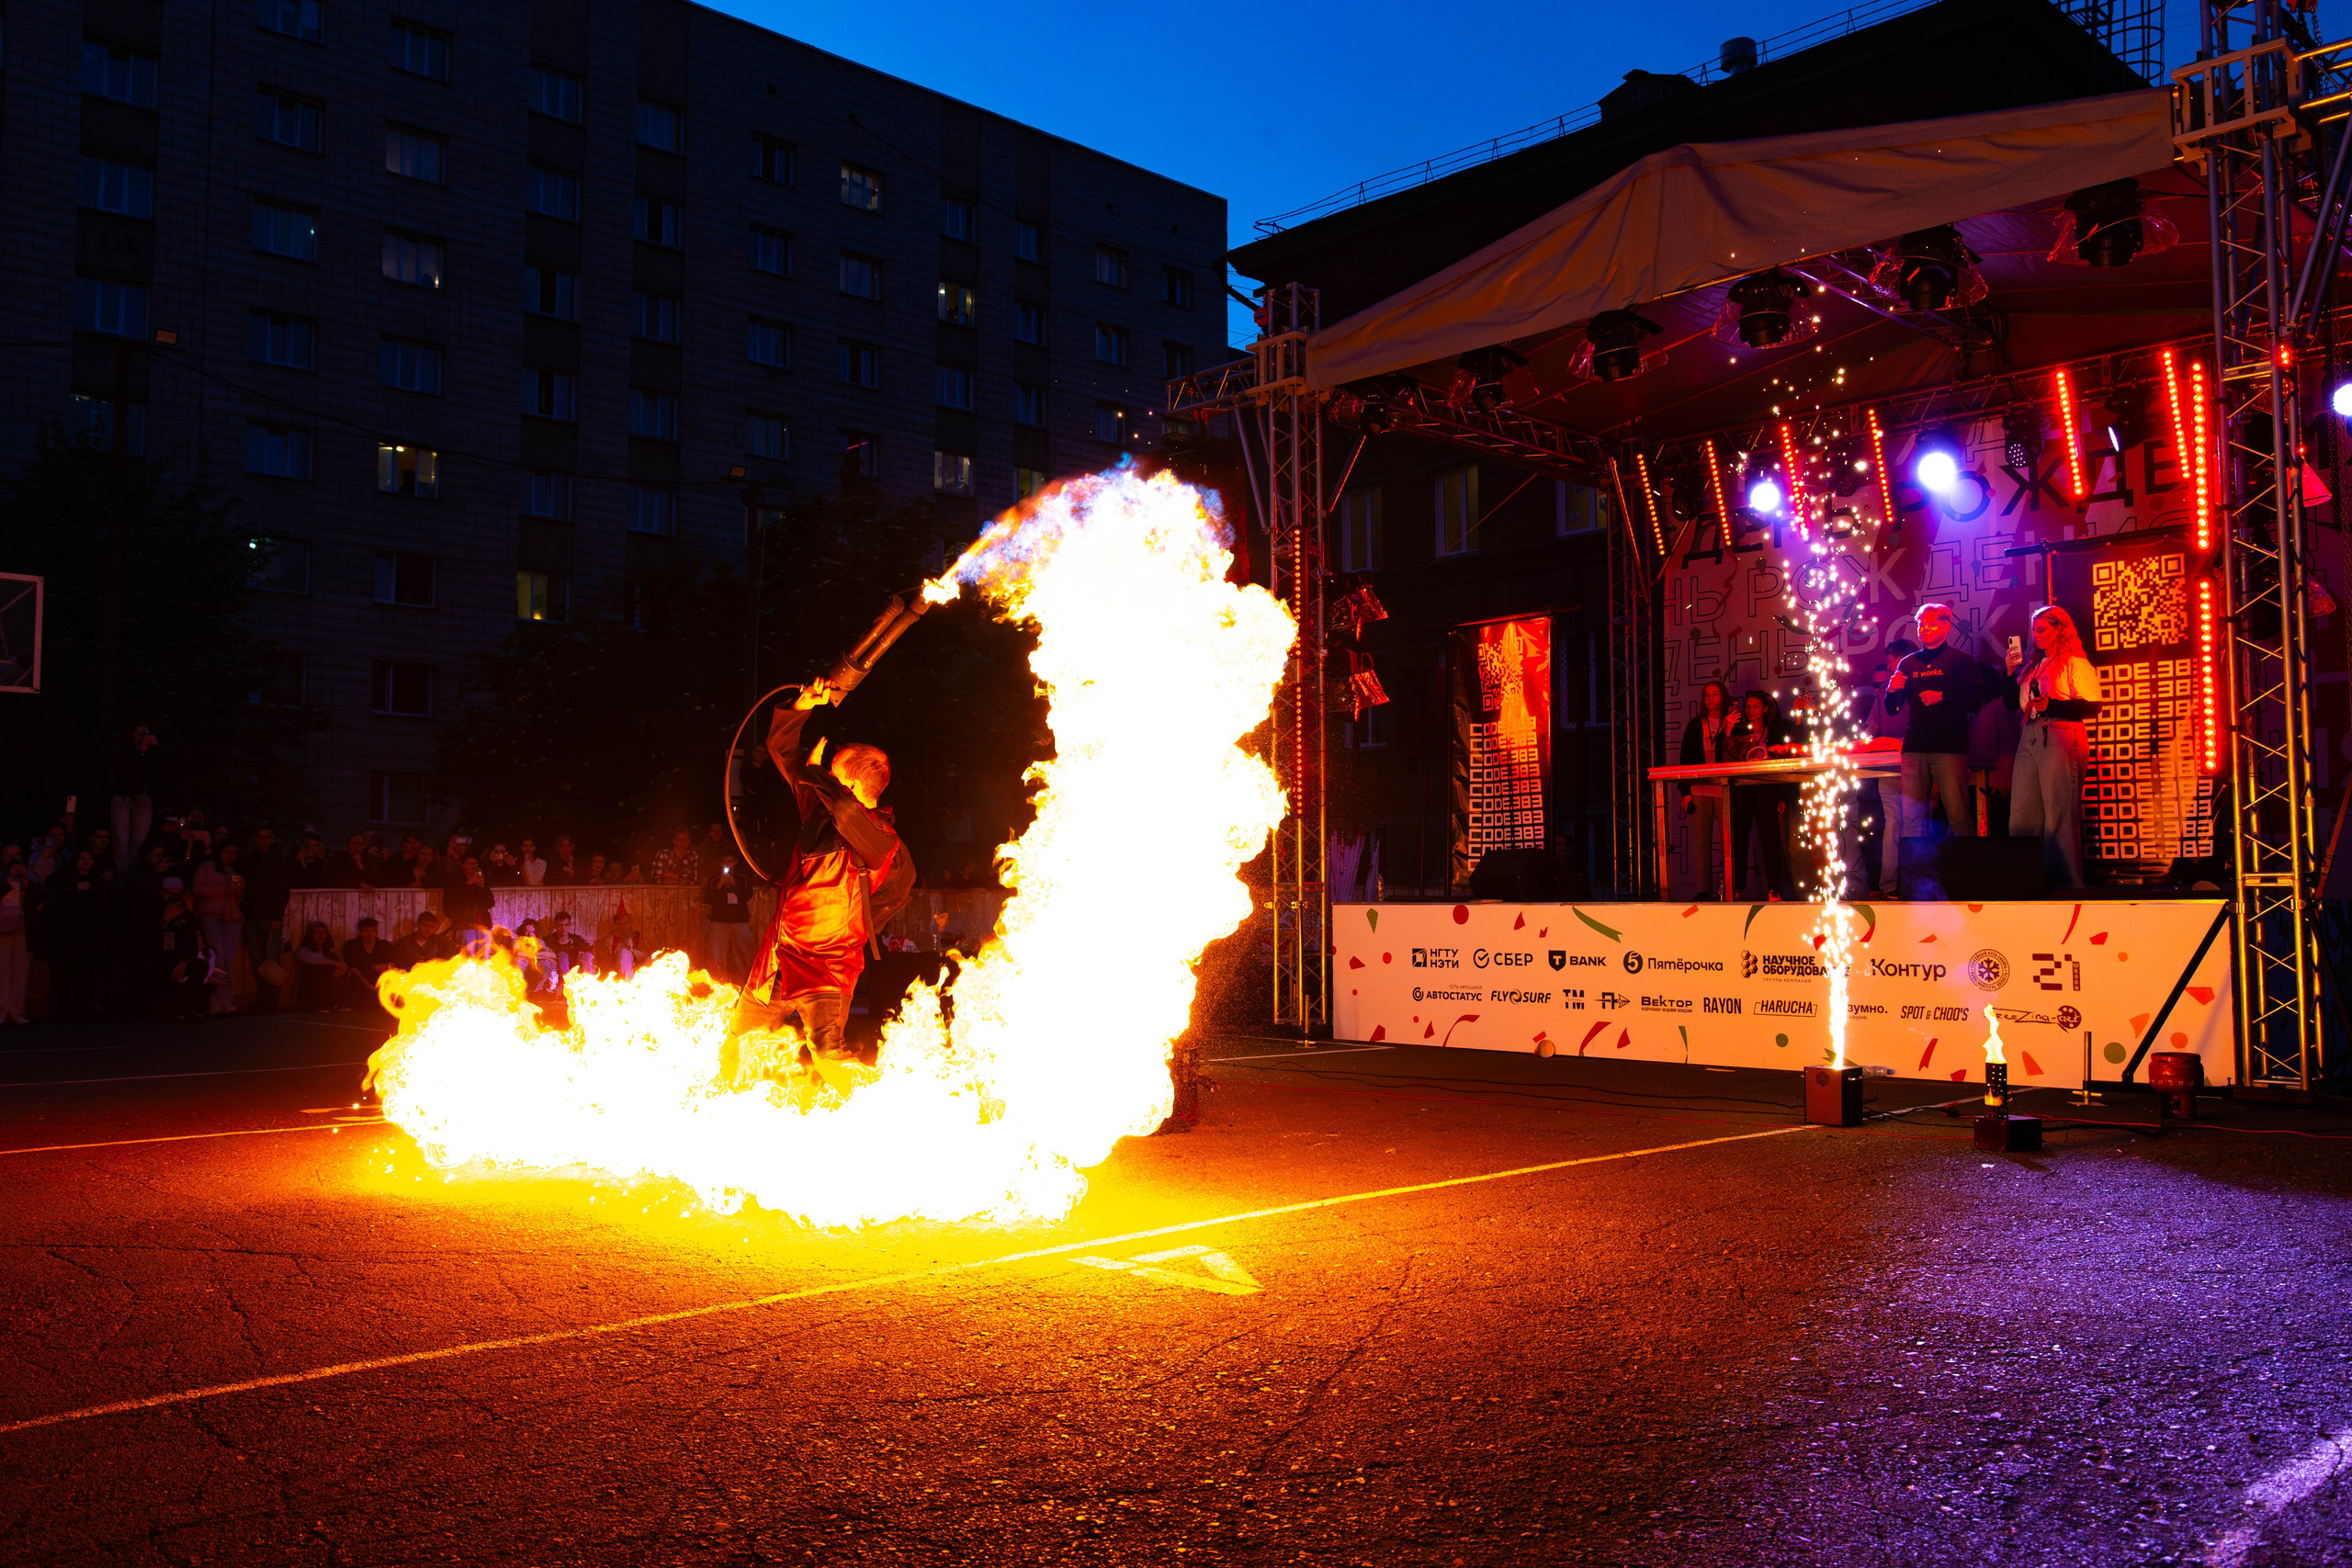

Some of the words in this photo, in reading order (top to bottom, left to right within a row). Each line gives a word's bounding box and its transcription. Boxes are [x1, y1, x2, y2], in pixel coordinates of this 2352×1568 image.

[1681, 493, 1862, 570] ДЕЬ
[2097, 659, 2199, 682] ODE.38
[2100, 678, 2199, 702] ODE.38
[2083, 698, 2199, 723] ODE.38
[1470, 748, 1539, 766] CODE.383
[1470, 763, 1540, 782] CODE.383
[1469, 779, 1542, 796] CODE.383
[2081, 779, 2213, 801] CODE.383
[1469, 795, 1543, 812] CODE.383
[2081, 799, 2211, 819] CODE.383
[1468, 810, 1544, 827] CODE.383
[1468, 826, 1544, 841] CODE.383
[2083, 819, 2214, 840] CODE.383
[2083, 840, 2214, 860] CODE.383
[1430, 948, 1459, 958] НГТУ
[1494, 953, 1533, 966] СБЕР
[1569, 956, 1607, 967] BANK
[1762, 954, 1815, 965] НАУЧНОЕ
[1430, 959, 1459, 968] НЭТИ
[1648, 957, 1724, 974] Пятёрочка
[1762, 964, 1850, 977] ОБОРУДОВА
[1871, 958, 1947, 982] Контур
[1426, 990, 1483, 1001] АВТОСТАТУС
[1703, 997, 1742, 1015] RAYON
[1760, 999, 1813, 1014] HARUCHA
[1847, 1004, 1888, 1015] зумно.
[1901, 1006, 1926, 1020] SPOT
[1933, 1007, 1969, 1021] CHOO'S
